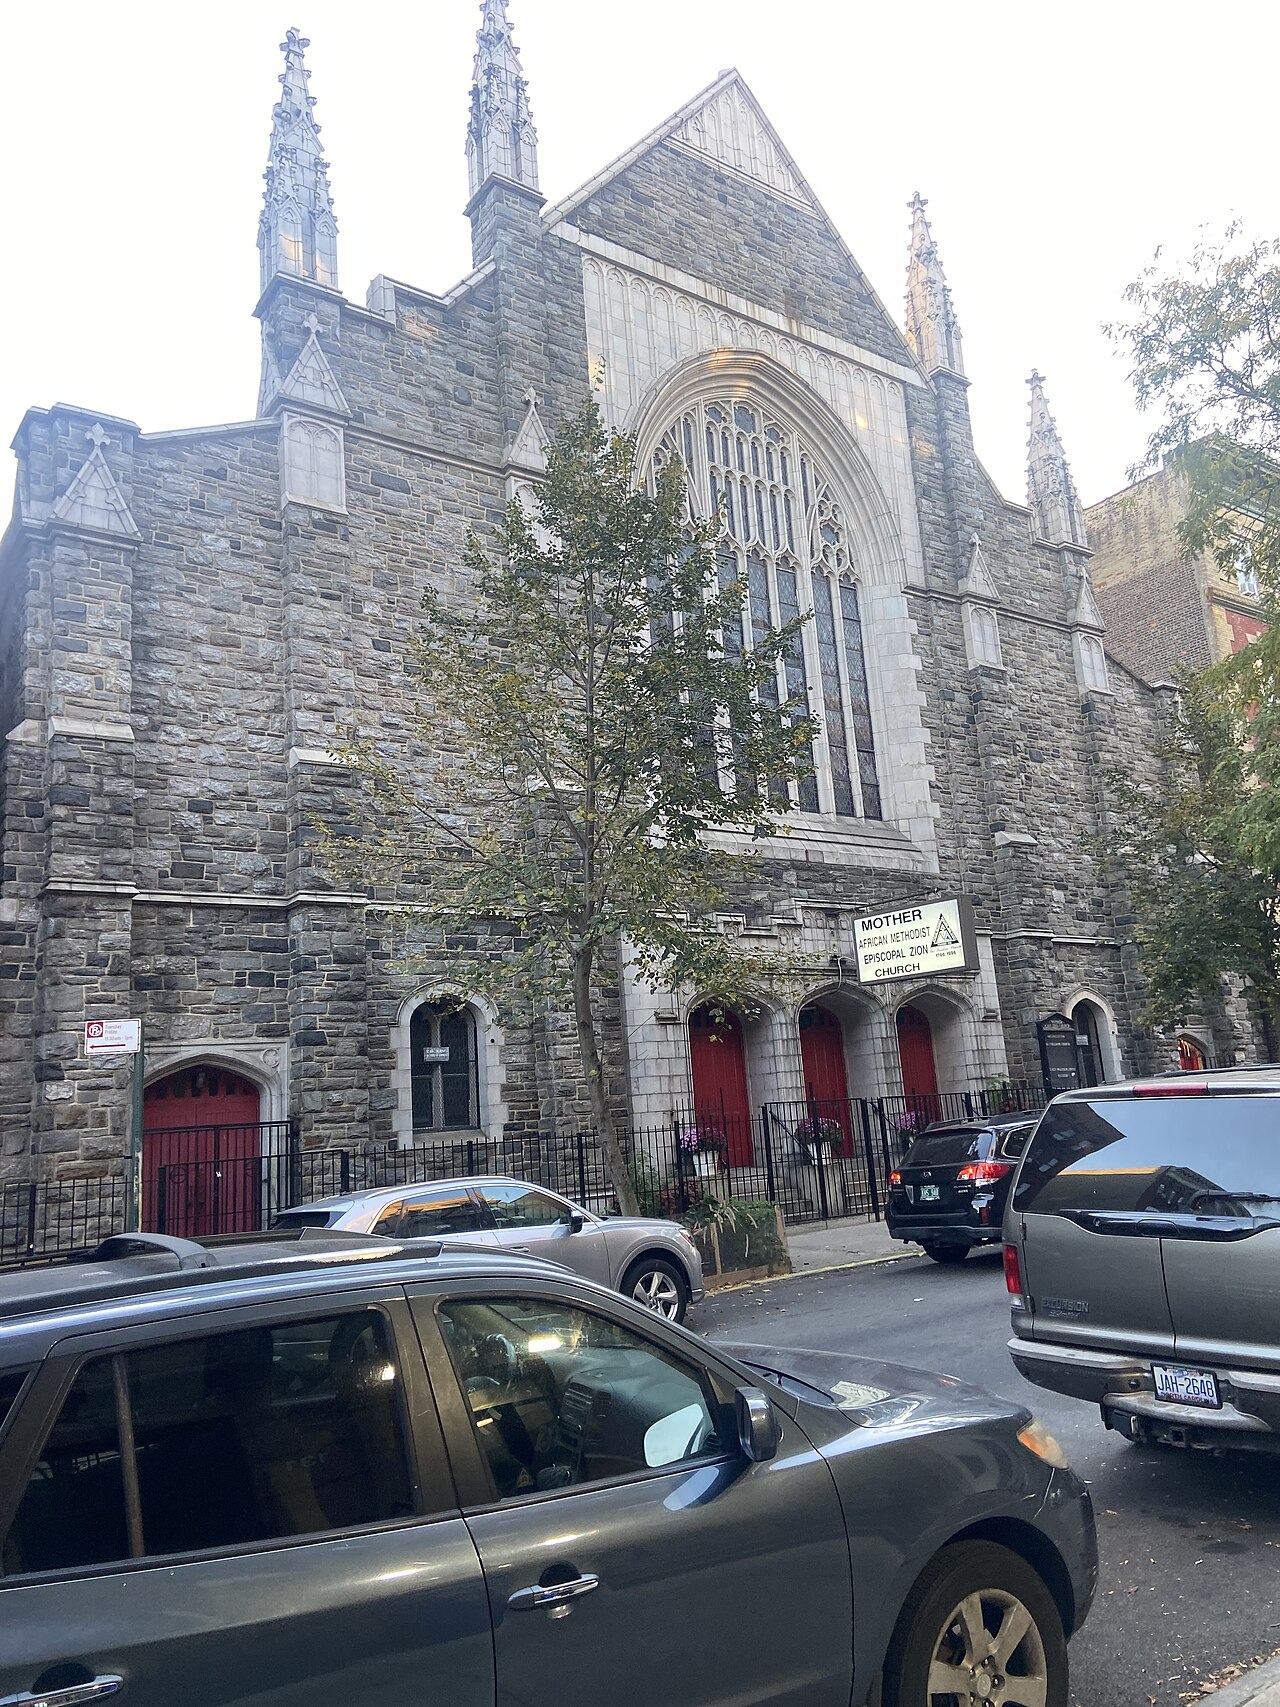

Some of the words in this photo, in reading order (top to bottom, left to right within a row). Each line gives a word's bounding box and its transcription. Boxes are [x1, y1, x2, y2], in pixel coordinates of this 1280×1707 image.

[862, 909, 922, 931] MOTHER
[859, 934, 888, 949] AFRICAN
[890, 927, 930, 943] METHODIST
[864, 949, 906, 964] EPISCOPAL
[910, 945, 928, 956] ZION
[875, 963, 920, 977] CHURCH
[1041, 1296, 1089, 1313] EXCURSION
[1158, 1374, 1215, 1398] JAH-2648
